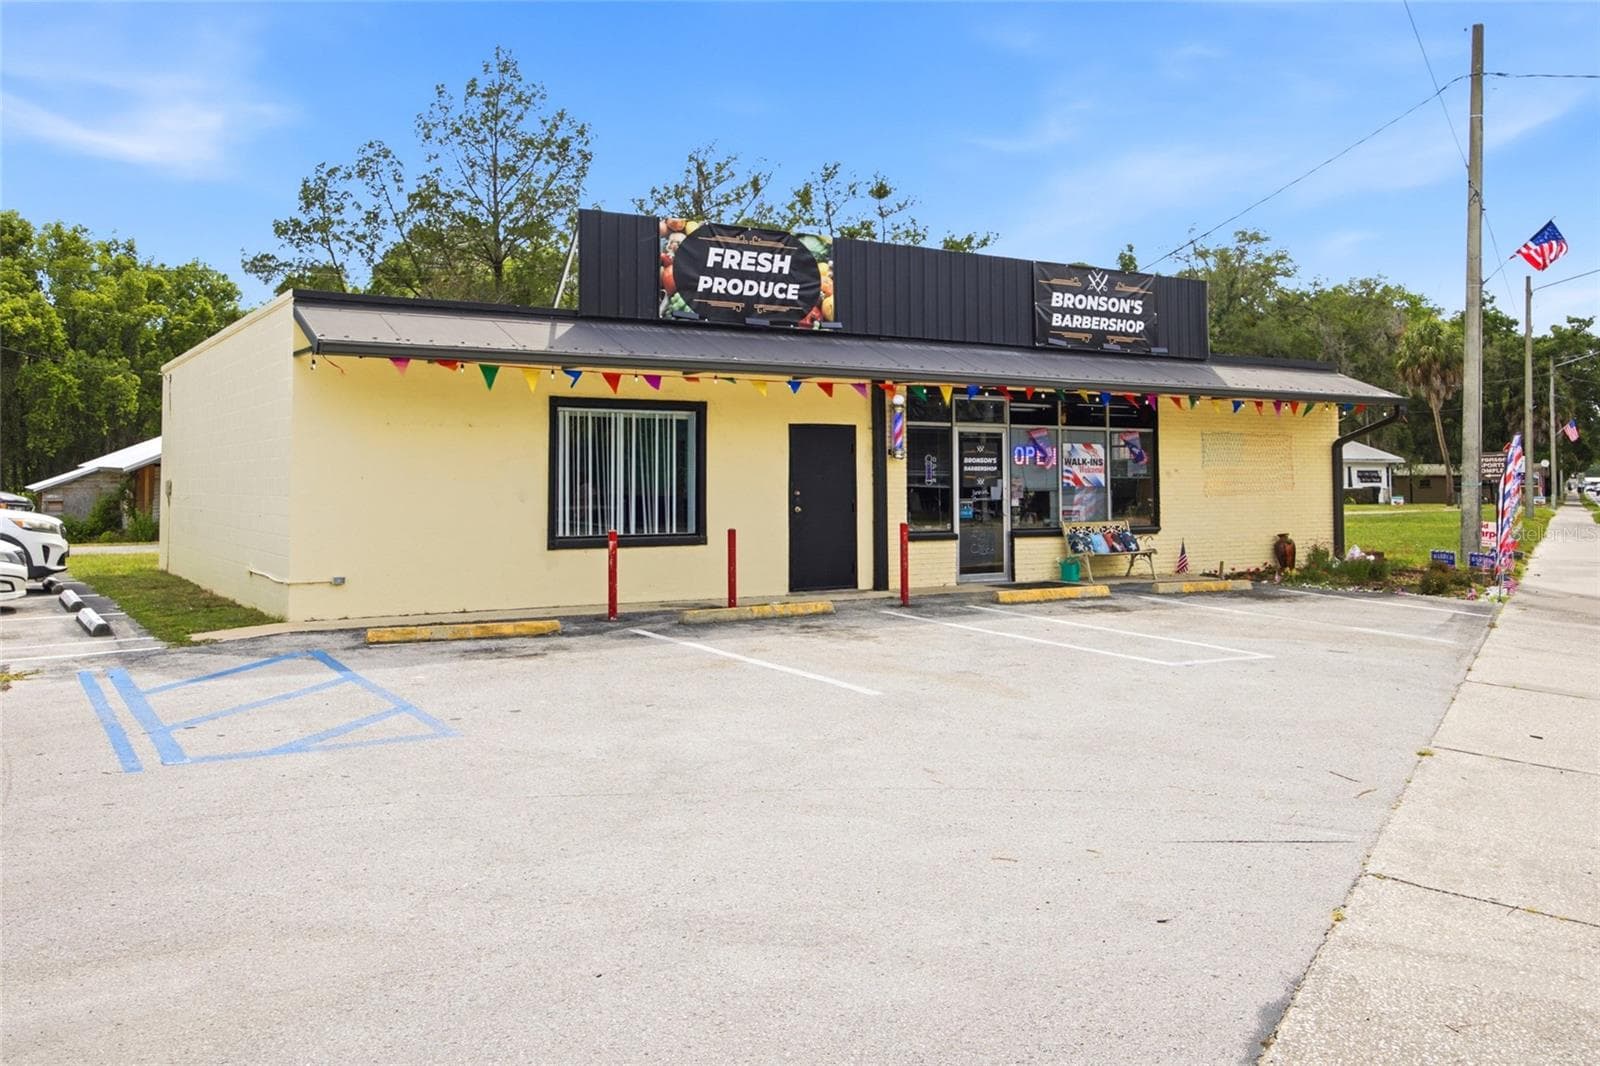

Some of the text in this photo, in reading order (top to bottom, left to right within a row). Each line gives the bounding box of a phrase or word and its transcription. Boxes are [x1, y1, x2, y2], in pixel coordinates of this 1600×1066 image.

[706, 247, 791, 274] FRESH
[697, 276, 800, 300] PRODUCE
[1051, 292, 1143, 315] BRONSON'S
[1051, 313, 1145, 333] BARBERSHOP
[1064, 457, 1104, 466] WALK-INS
